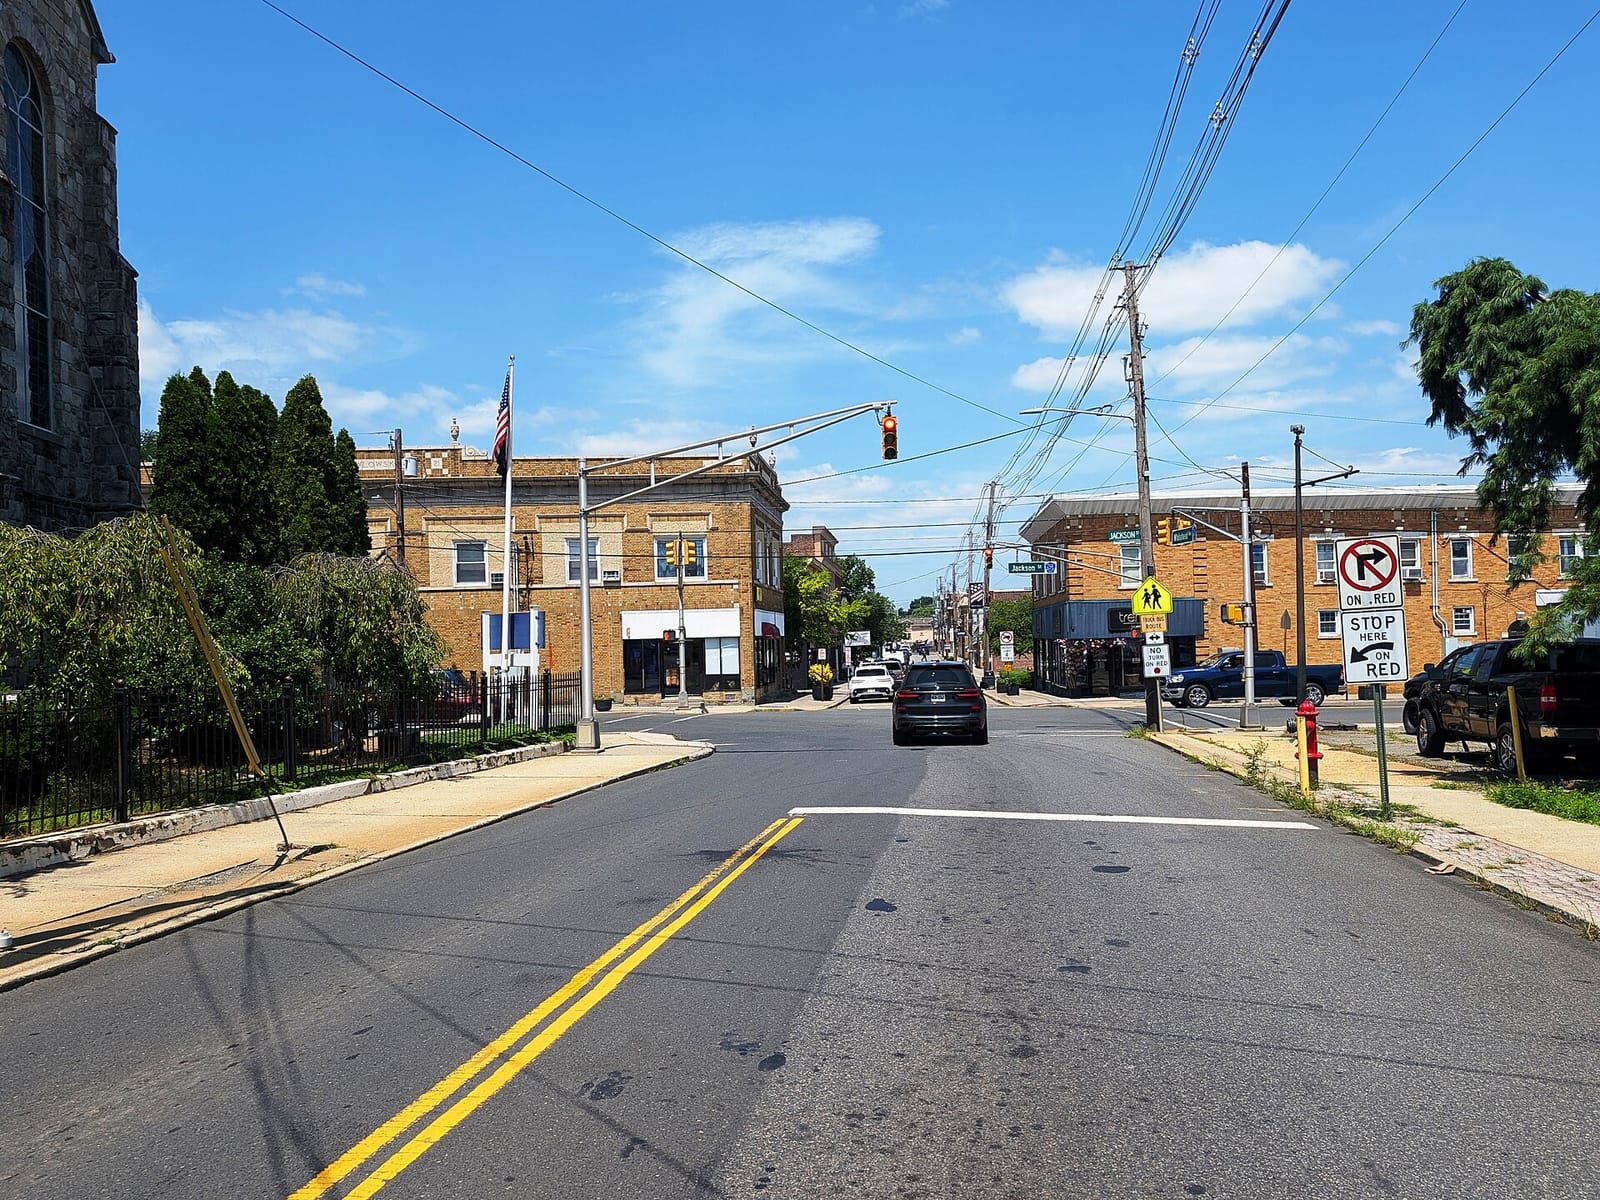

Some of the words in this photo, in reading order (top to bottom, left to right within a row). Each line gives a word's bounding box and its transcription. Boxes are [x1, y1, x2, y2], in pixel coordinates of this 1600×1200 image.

[1109, 531, 1136, 540] JACKSON
[1012, 564, 1036, 572] Jackson
[1346, 594, 1361, 606] ON
[1374, 593, 1395, 604] RED
[1350, 616, 1396, 631] STOP
[1360, 632, 1388, 641] HERE
[1375, 652, 1390, 660] ON
[1366, 662, 1401, 678] RED
